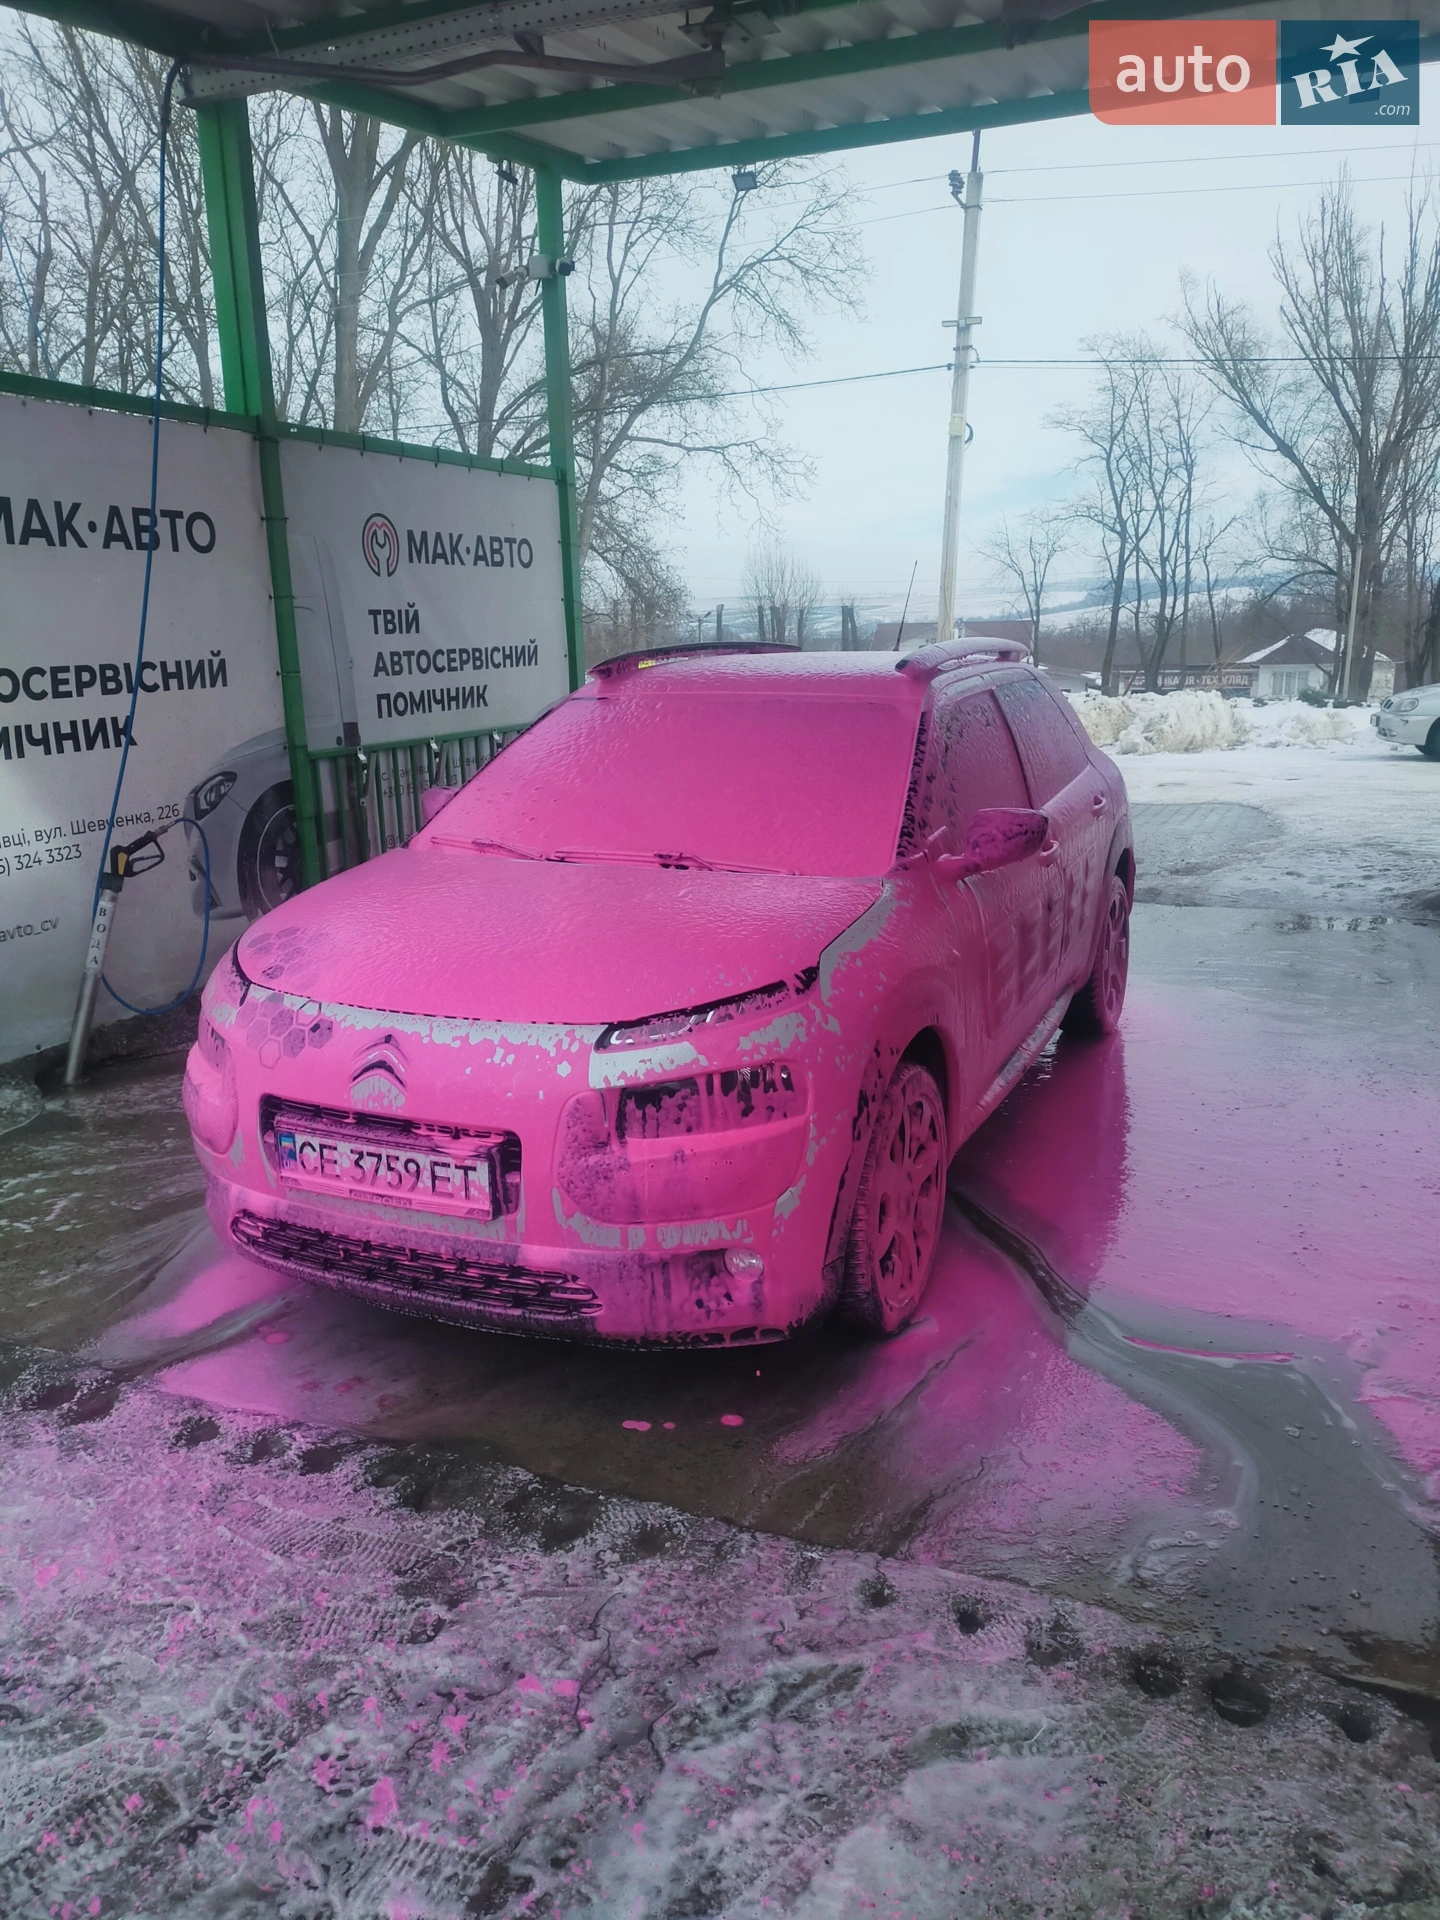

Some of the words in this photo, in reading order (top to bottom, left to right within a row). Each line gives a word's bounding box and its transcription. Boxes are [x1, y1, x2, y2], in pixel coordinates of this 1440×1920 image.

[407, 529, 533, 569] МАК·АВТО
[368, 602, 420, 635] ТВІЙ
[373, 639, 538, 677] АВТОСЕРВІСНИЙ
[376, 684, 488, 719] ПОМІЧНИК
[35, 827, 66, 844] вул.
[157, 804, 180, 820] 226
[14, 851, 42, 870] 324
[45, 844, 82, 864] 3323
[299, 1141, 341, 1179] CE
[349, 1150, 421, 1193] 3759
[430, 1160, 477, 1200] ET
